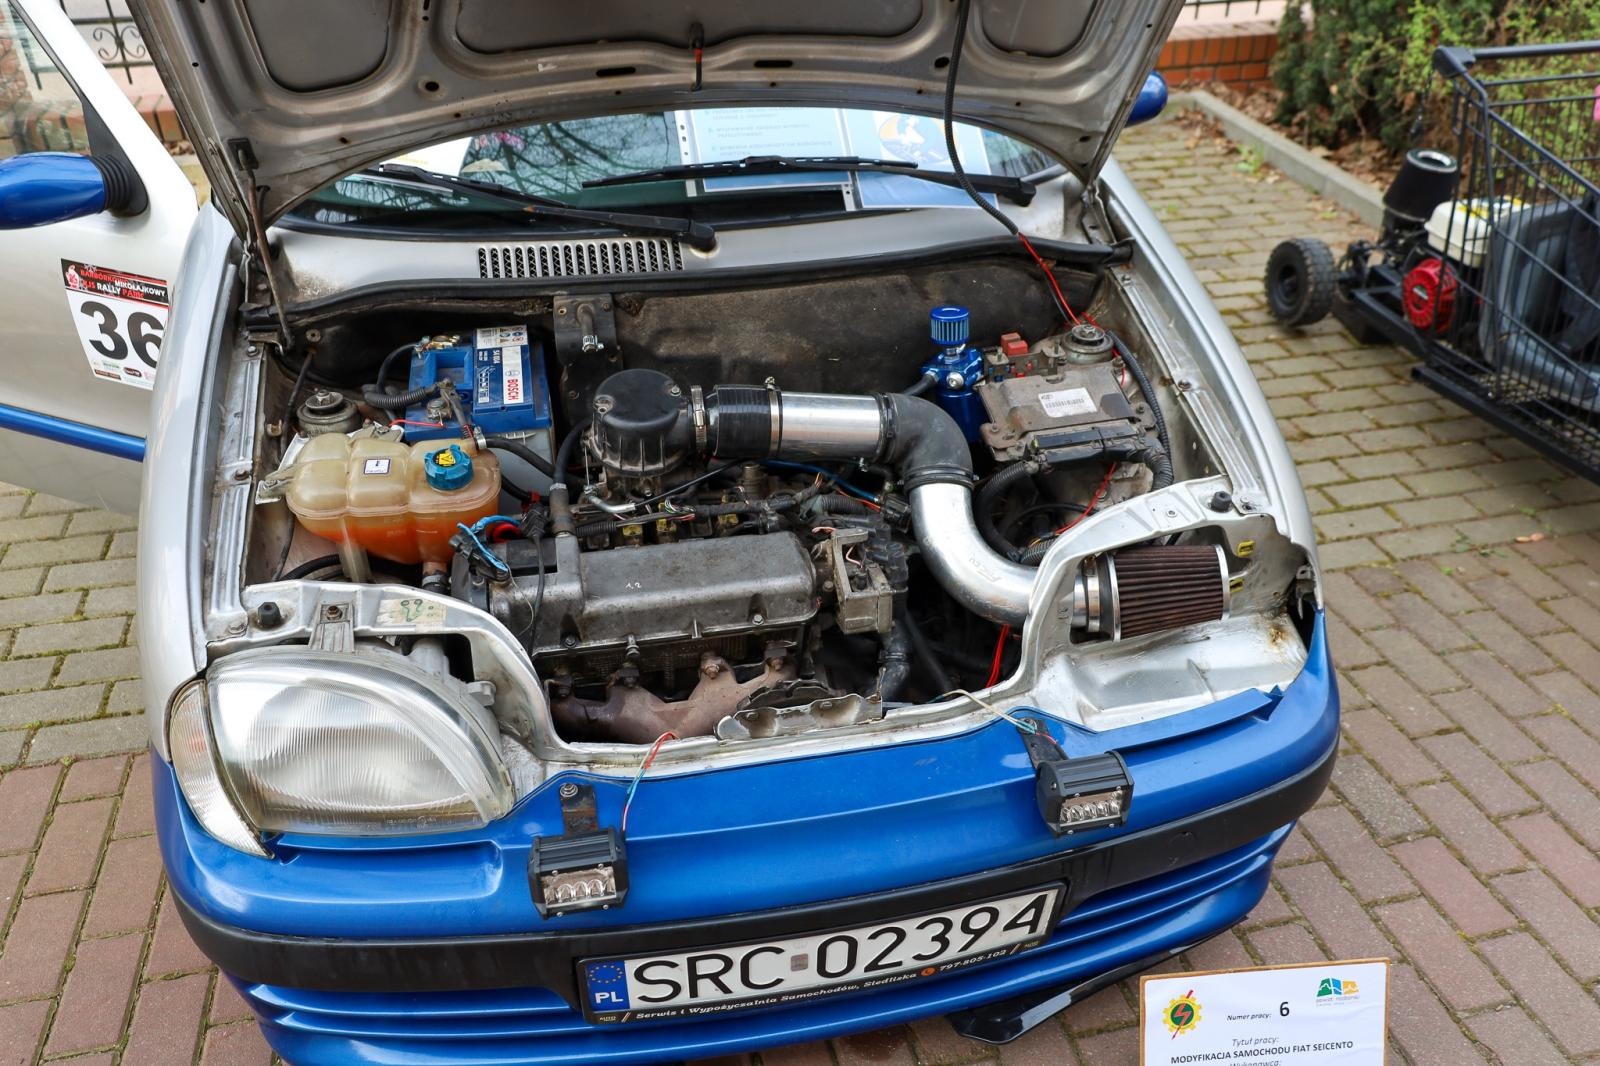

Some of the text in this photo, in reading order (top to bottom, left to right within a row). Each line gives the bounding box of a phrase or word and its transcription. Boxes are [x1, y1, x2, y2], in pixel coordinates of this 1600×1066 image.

[96, 282, 121, 295] RALLY
[80, 300, 164, 369] 36
[507, 378, 520, 401] BOSCH
[633, 893, 1048, 1003] SRC 02394
[594, 991, 624, 1004] PL
[636, 1009, 677, 1019] Serwis
[1226, 1013, 1251, 1021] Numer
[1279, 1001, 1290, 1017] 6
[1253, 1036, 1280, 1046] pracy:
[1170, 1040, 1354, 1065] MODYFIKACJA SAMOCHODU FIAT SEICENTO
